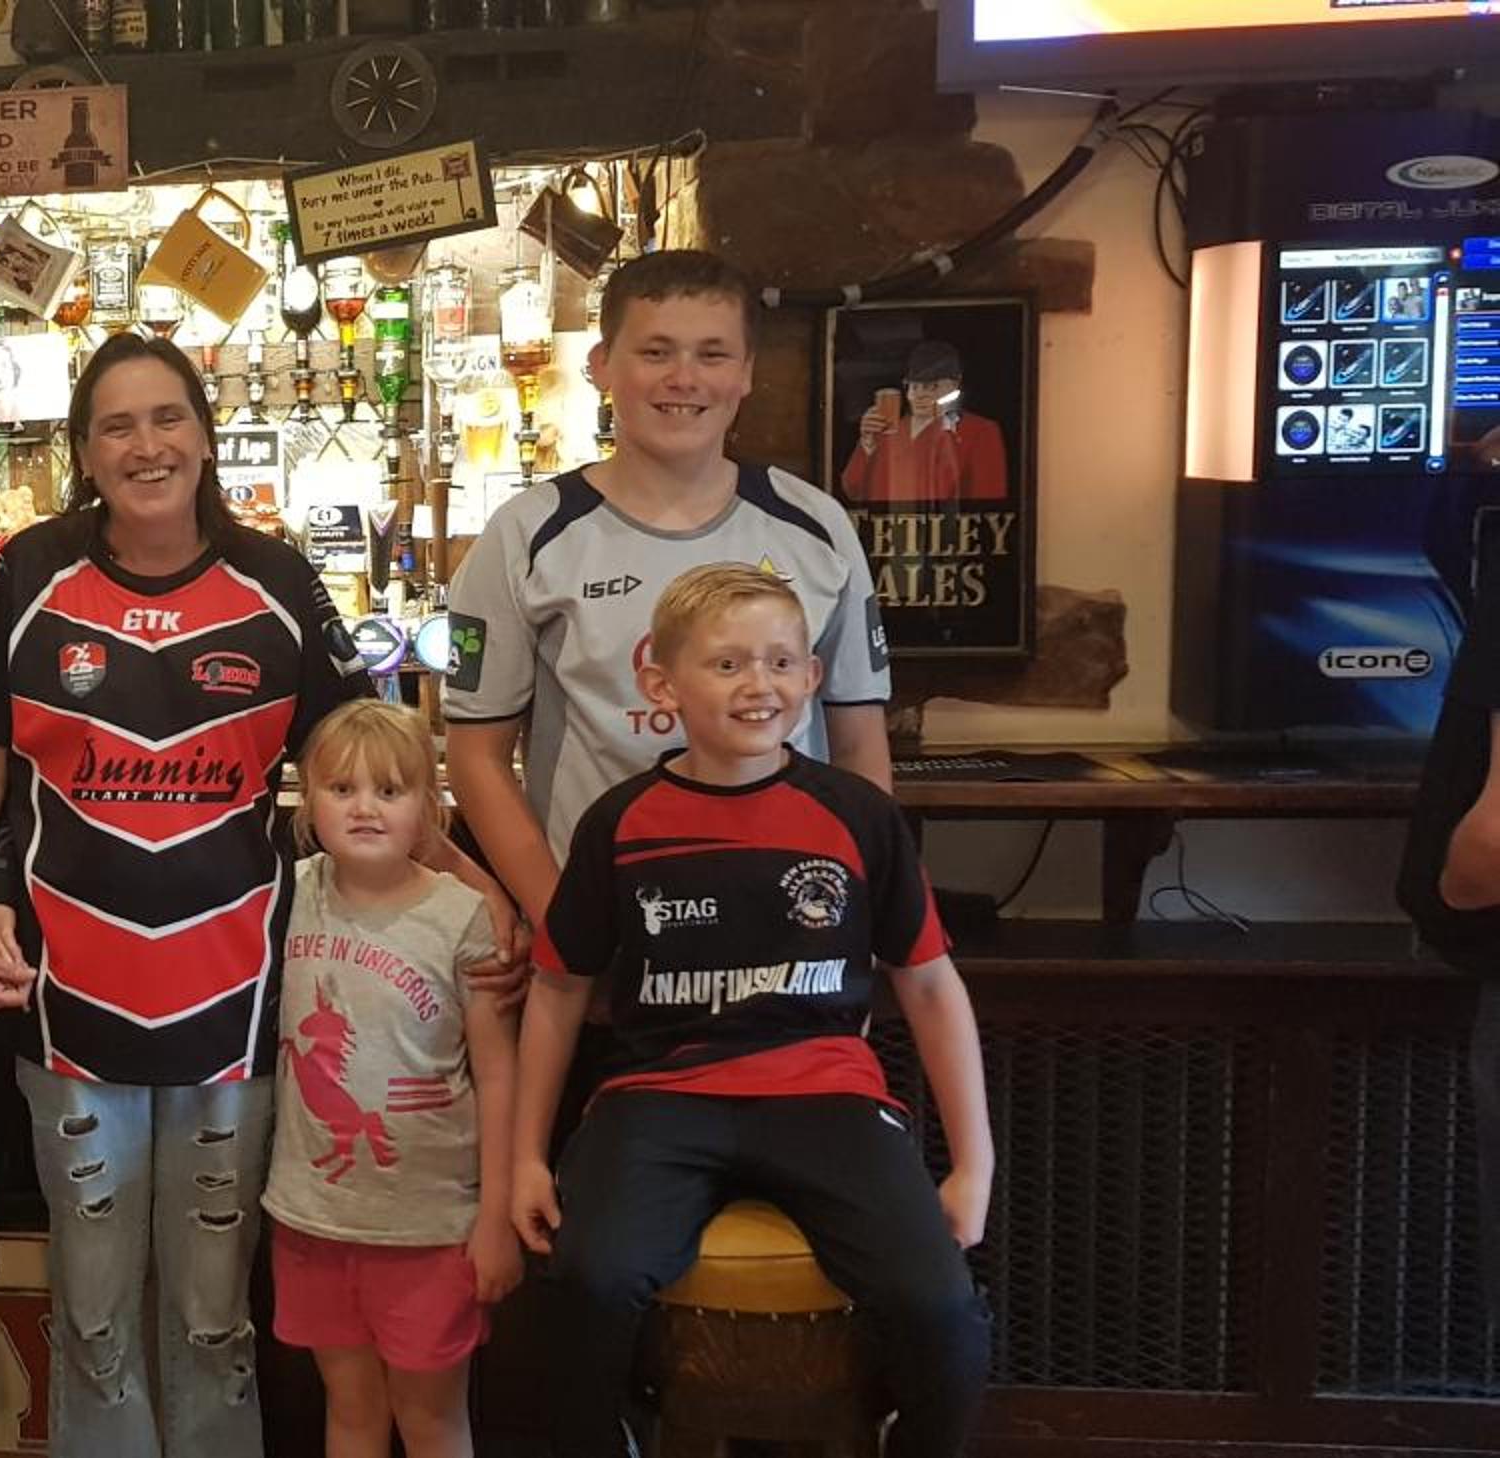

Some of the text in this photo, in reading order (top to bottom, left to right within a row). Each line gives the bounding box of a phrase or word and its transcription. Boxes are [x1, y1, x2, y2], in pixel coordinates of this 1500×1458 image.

[18, 160, 40, 173] BE
[337, 170, 372, 188] When
[300, 191, 327, 210] Bury
[352, 185, 385, 200] under
[389, 177, 409, 191] the
[323, 231, 332, 247] 7
[336, 225, 376, 245] times
[380, 223, 389, 235] a
[238, 437, 271, 465] Age
[876, 562, 986, 608] ALES
[122, 608, 181, 632] GTK
[72, 736, 245, 801] Dunning
[81, 789, 199, 803] PLANT HIRE
[657, 897, 717, 921] STAG
[329, 936, 351, 961] IN
[355, 941, 440, 1022] UNICORNS
